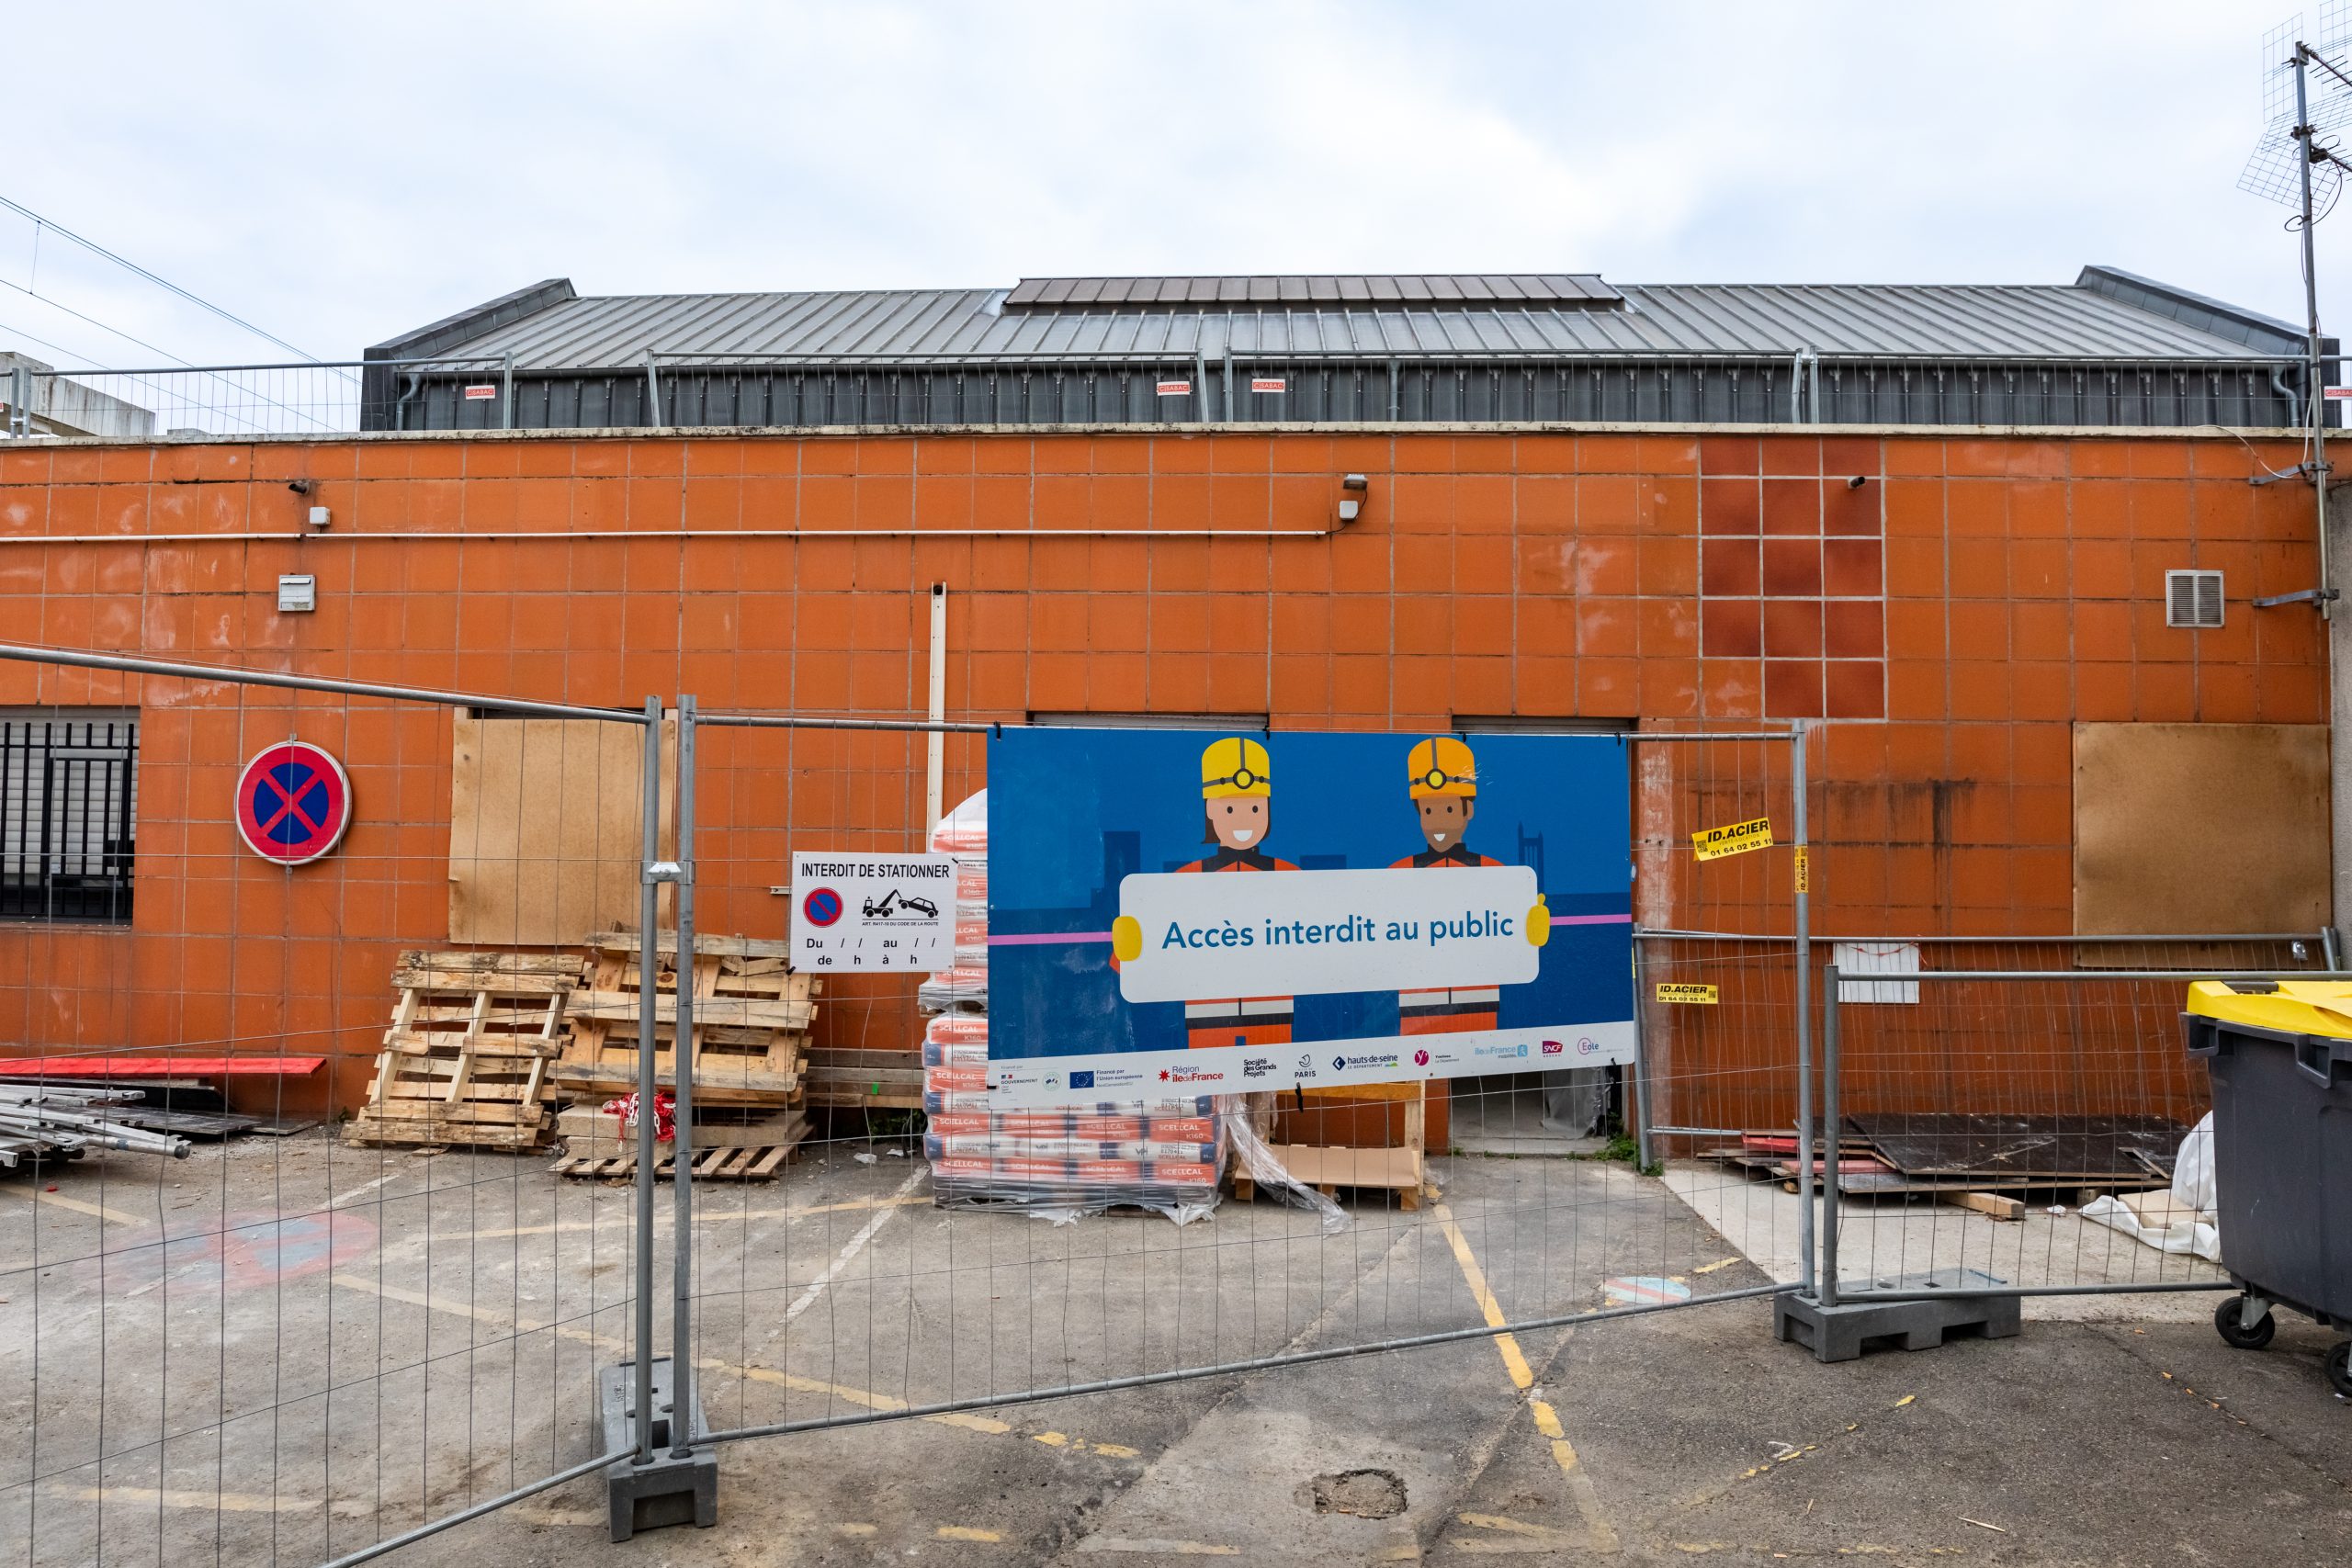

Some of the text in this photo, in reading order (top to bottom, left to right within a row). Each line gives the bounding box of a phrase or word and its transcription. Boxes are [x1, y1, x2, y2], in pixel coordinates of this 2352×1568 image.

[1707, 820, 1770, 843] ID.ACIER
[1750, 840, 1761, 848] 55
[1763, 837, 1772, 845] 11
[801, 863, 950, 878] INTERDIT DE STATIONNER
[1161, 910, 1514, 950] Accès interdit au public
[807, 938, 823, 949] Du
[883, 939, 898, 948] au
[818, 954, 917, 965] de h à h
[1659, 985, 1708, 994] ID.ACIER
[1243, 1057, 1268, 1066] Société
[1171, 1066, 1200, 1076] Région
[1255, 1063, 1277, 1071] Grands
[936, 1072, 977, 1080] SCELLCAL
[1243, 1070, 1266, 1078] Projets
[1294, 1070, 1317, 1078] PARIS
[1158, 1123, 1200, 1132] SCELLCAL
